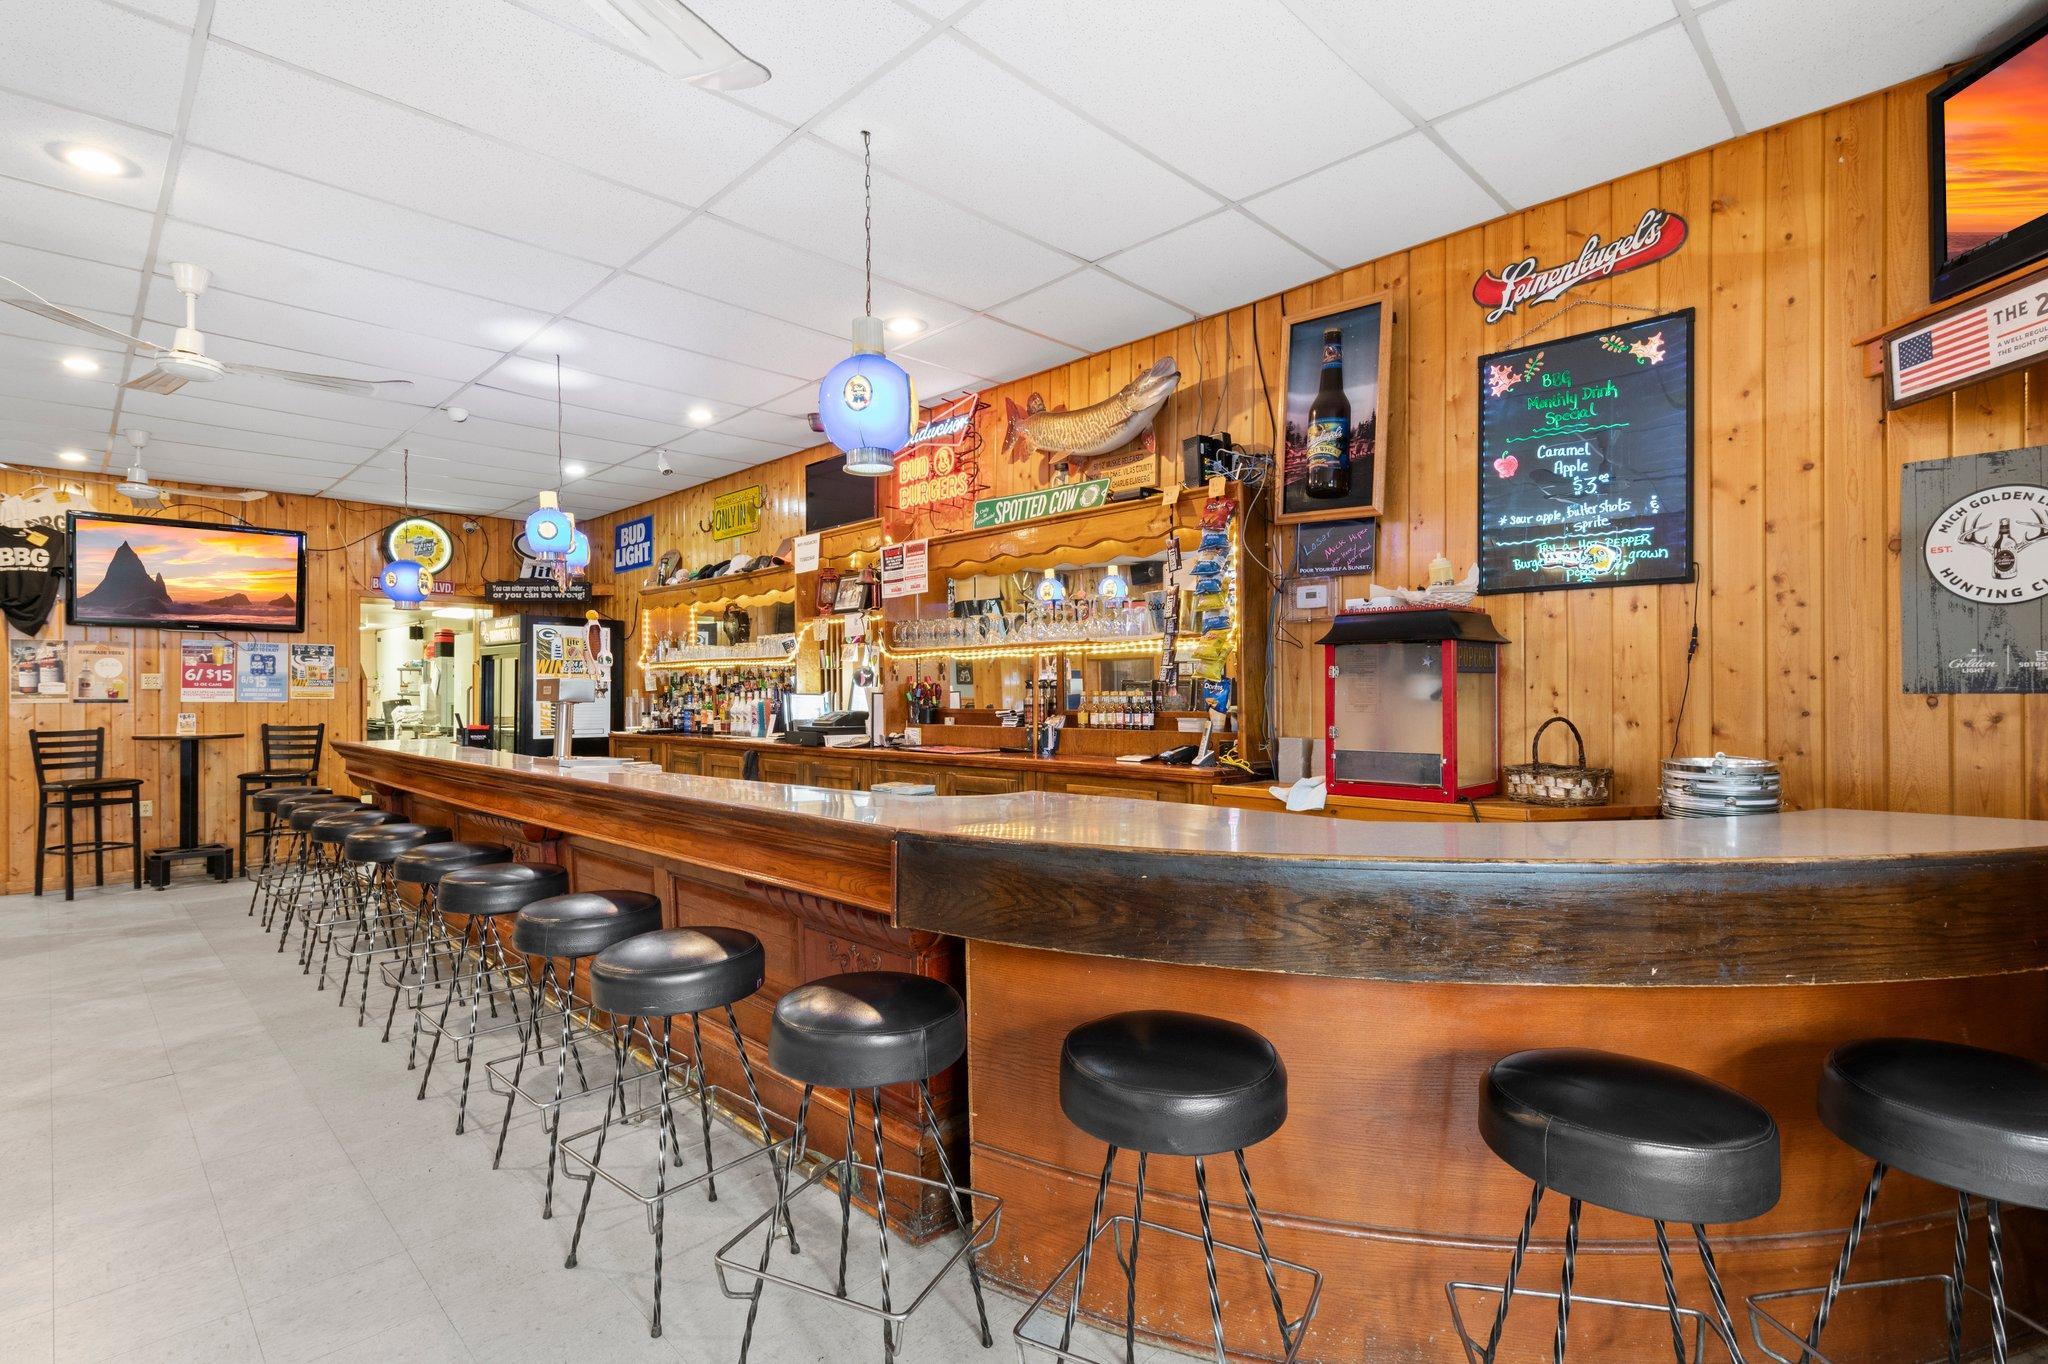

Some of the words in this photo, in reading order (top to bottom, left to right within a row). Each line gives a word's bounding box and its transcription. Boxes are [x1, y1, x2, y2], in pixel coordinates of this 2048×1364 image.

[1485, 208, 1662, 324] Leinenkugel's
[1993, 300, 2029, 326] THE
[1997, 347, 2012, 357] THE
[2014, 338, 2037, 351] RIGHT
[2004, 335, 2023, 346] WELL
[1541, 370, 1573, 388] BBG
[1527, 391, 1578, 410] Monthly
[1581, 379, 1618, 401] Drink
[1545, 402, 1597, 428] Special
[904, 414, 970, 448] udweiser
[1537, 442, 1591, 459] Caramel
[900, 456, 929, 484] BUD
[1554, 459, 1588, 477] Apple
[900, 472, 968, 509] BURGERS
[994, 494, 1048, 524] SPOTTED
[1049, 487, 1080, 514] COW
[1938, 506, 1967, 533] MICH
[1969, 491, 2035, 509] GOLDEN
[1509, 514, 1533, 525] sour
[1573, 516, 1612, 532] sprite
[620, 522, 646, 547] BUD
[1303, 527, 1336, 556] Loser
[0, 547, 50, 567] BBG
[615, 541, 650, 568] LIGHT
[1930, 545, 1953, 555] EST.
[1940, 567, 2023, 599] HUNTING
[1457, 647, 1495, 668] POPCORN
[1948, 658, 1998, 669] Golden
[206, 669, 232, 682] $15
